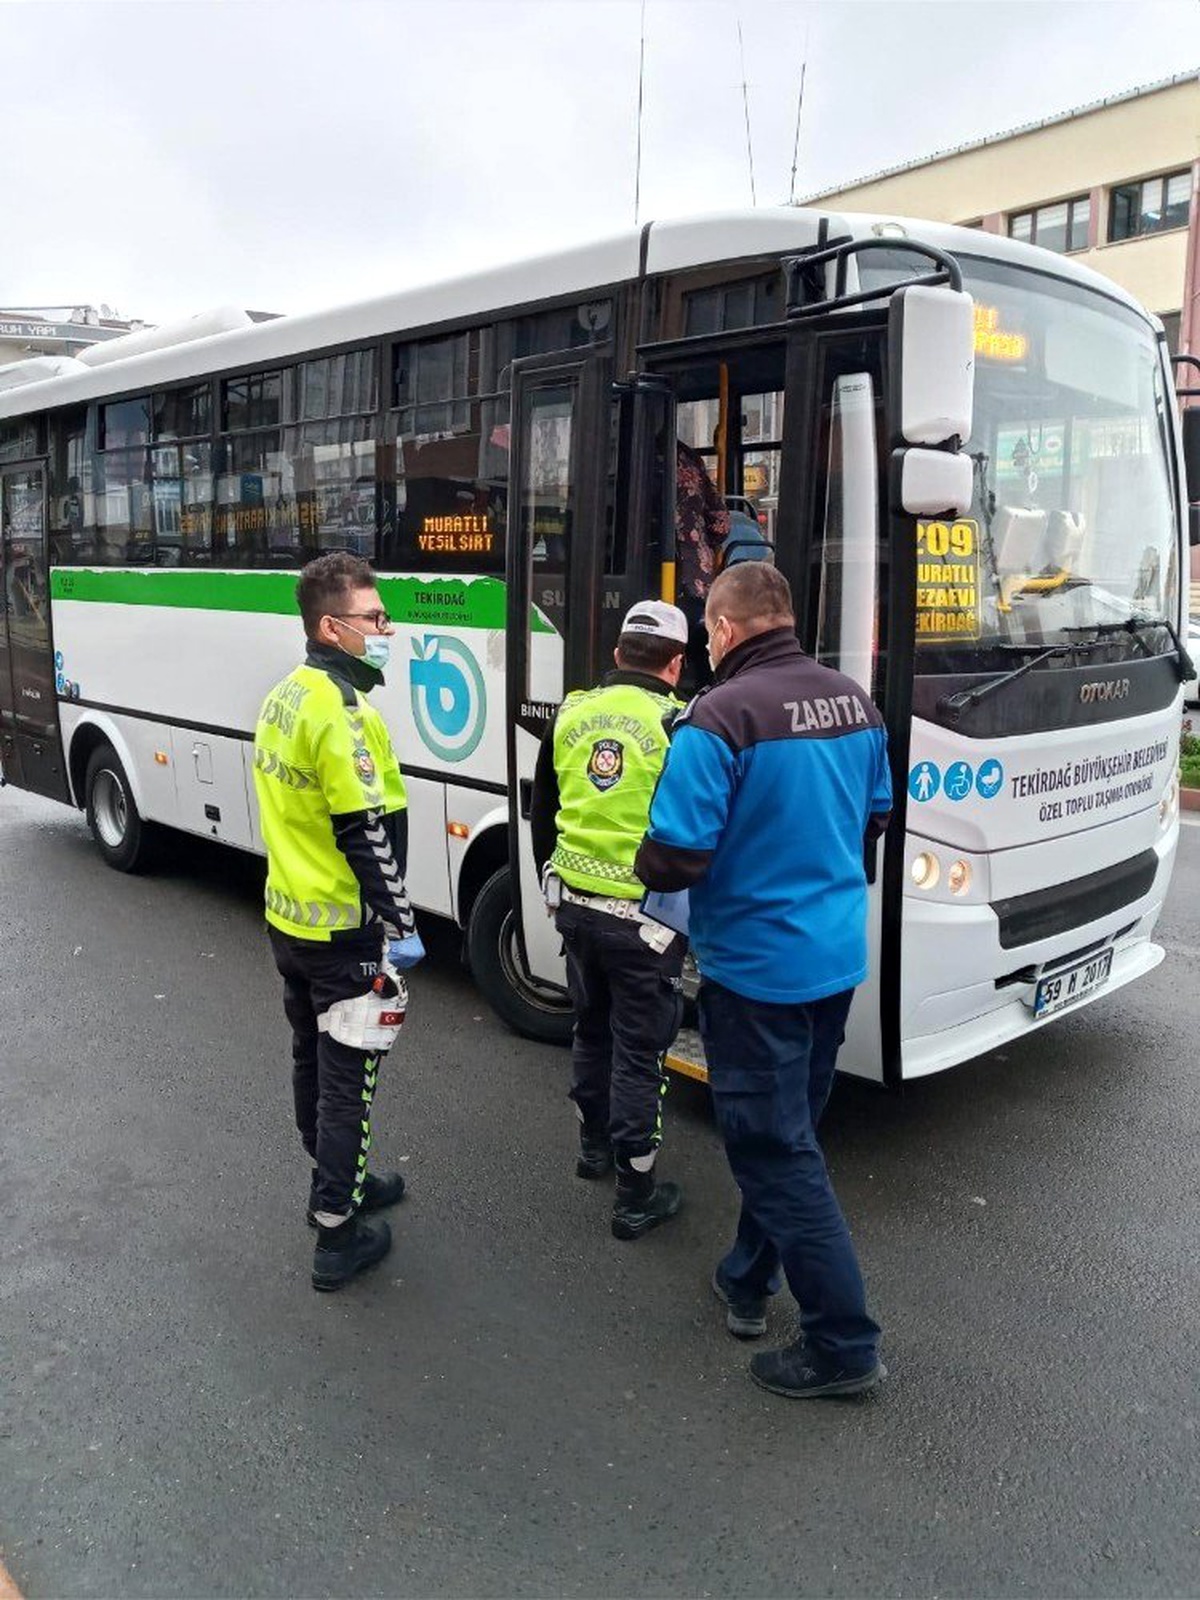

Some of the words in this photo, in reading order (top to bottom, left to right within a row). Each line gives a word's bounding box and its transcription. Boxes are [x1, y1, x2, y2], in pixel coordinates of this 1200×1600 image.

[424, 515, 487, 532] MURATLI
[917, 564, 974, 583] URATLI
[414, 590, 465, 606] TEKİRDAĞ
[917, 585, 975, 607] EZAEVİ
[917, 609, 975, 632] KİRDAĞ
[1081, 678, 1130, 704] OTOKAR
[783, 695, 869, 733] ZABITA
[1012, 763, 1071, 799] TEKİRDAĞ
[1074, 749, 1131, 786] BÜYÜKŞEHİR
[1039, 802, 1063, 822] ÖZEL
[1066, 794, 1094, 816] TOPLU
[1043, 979, 1062, 1004] 59
